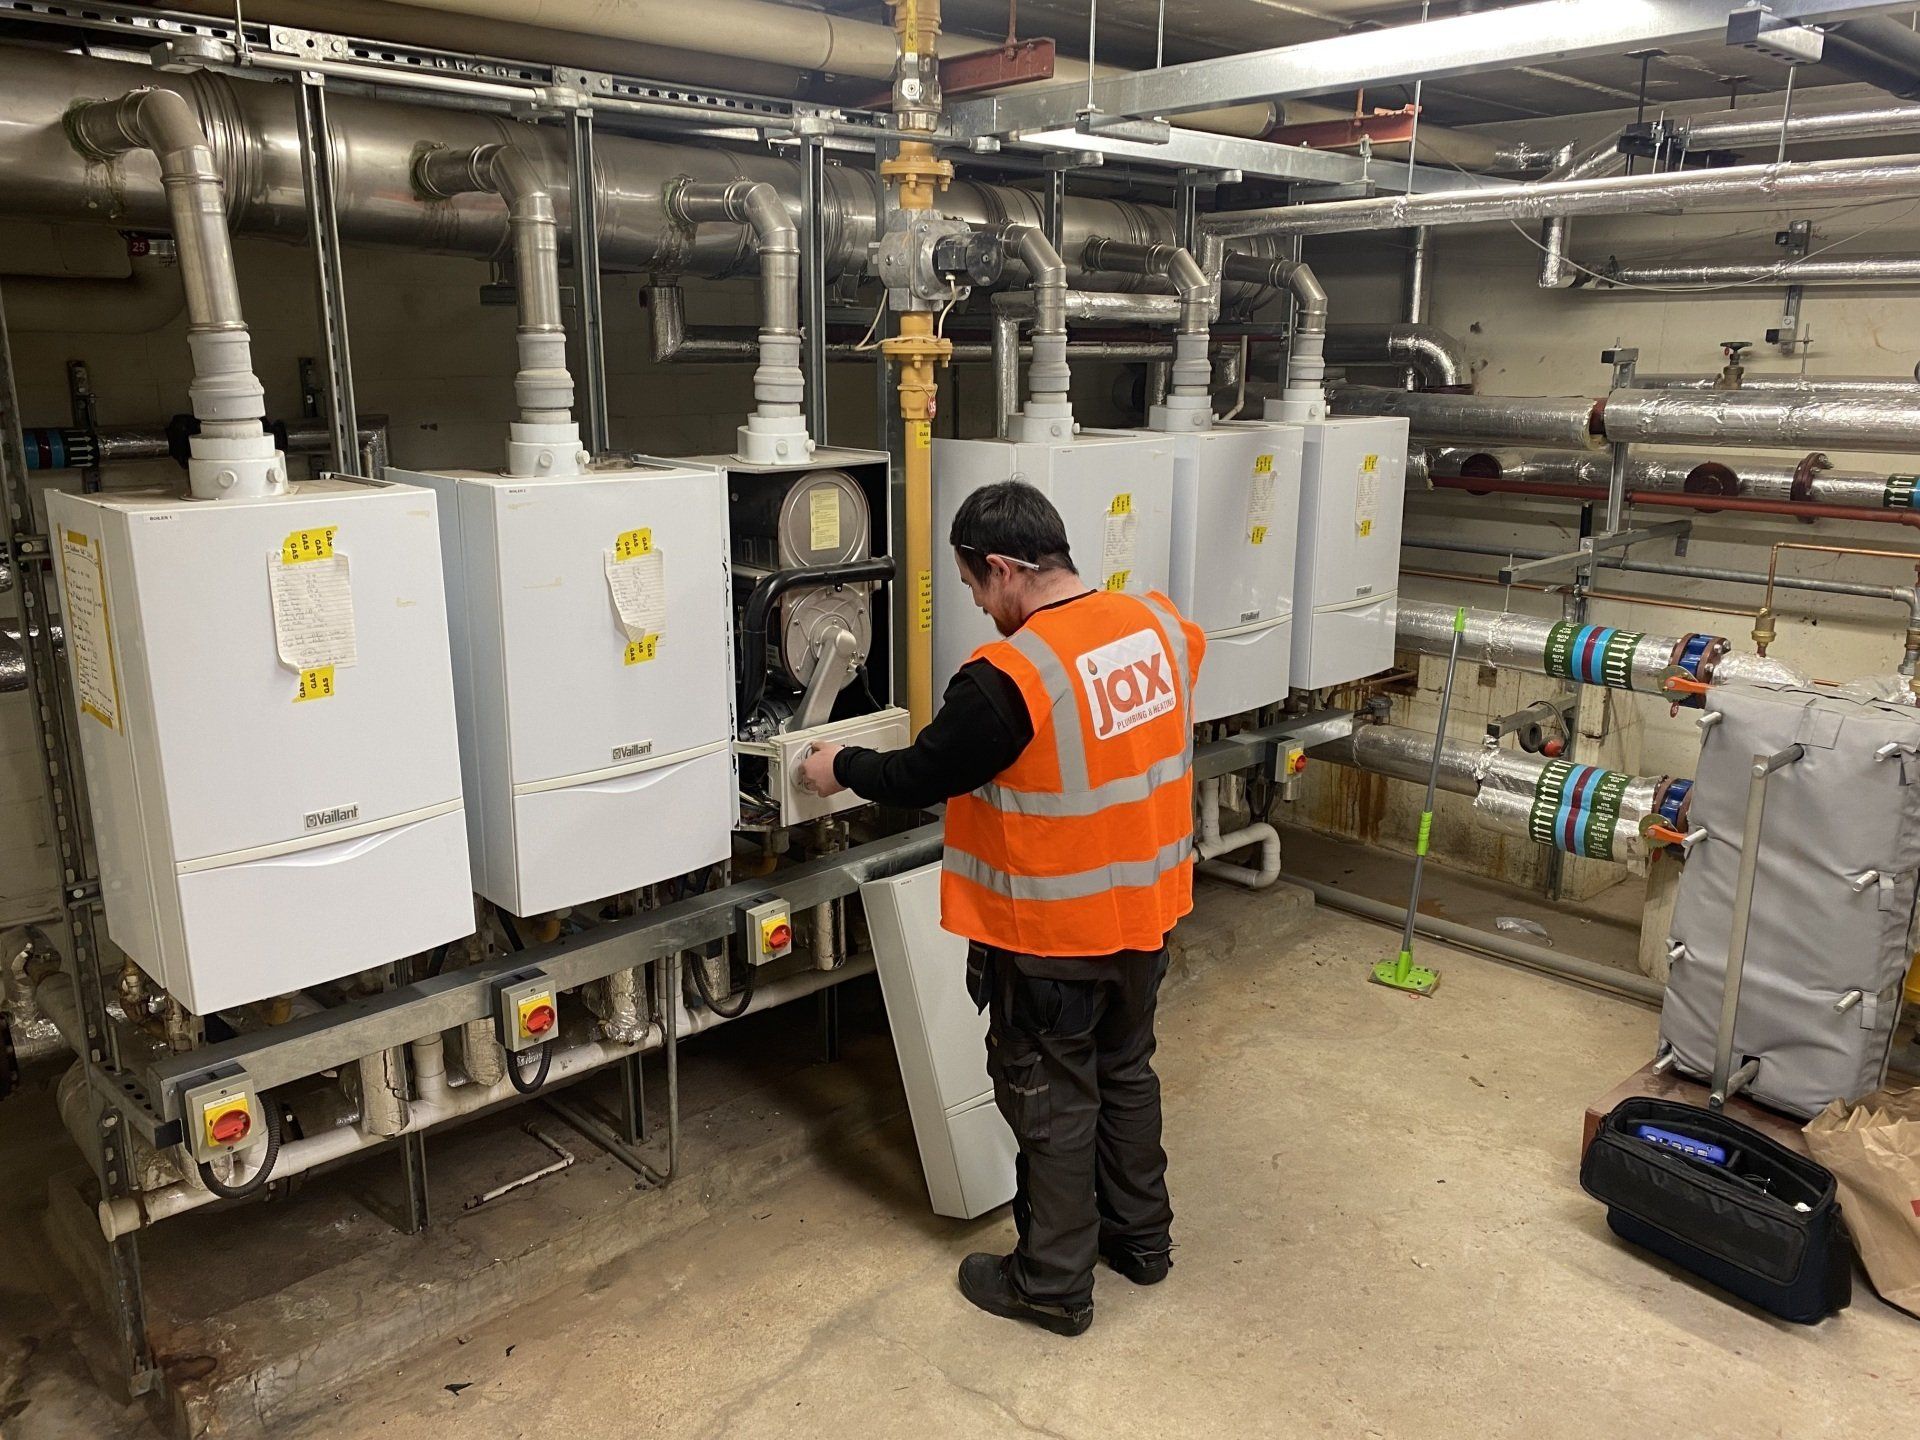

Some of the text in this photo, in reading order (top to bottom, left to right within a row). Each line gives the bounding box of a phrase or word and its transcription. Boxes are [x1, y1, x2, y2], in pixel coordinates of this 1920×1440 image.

[132, 242, 145, 252] 25
[290, 542, 299, 560] GAS
[301, 533, 310, 551] GAS
[314, 539, 323, 556] GAS
[322, 677, 330, 694] GAS
[1088, 651, 1171, 737] jax
[1117, 711, 1148, 731] PLUMBING
[1153, 698, 1175, 714] HEATING
[620, 741, 652, 758] Vaillant
[316, 805, 359, 825] Vaillant
